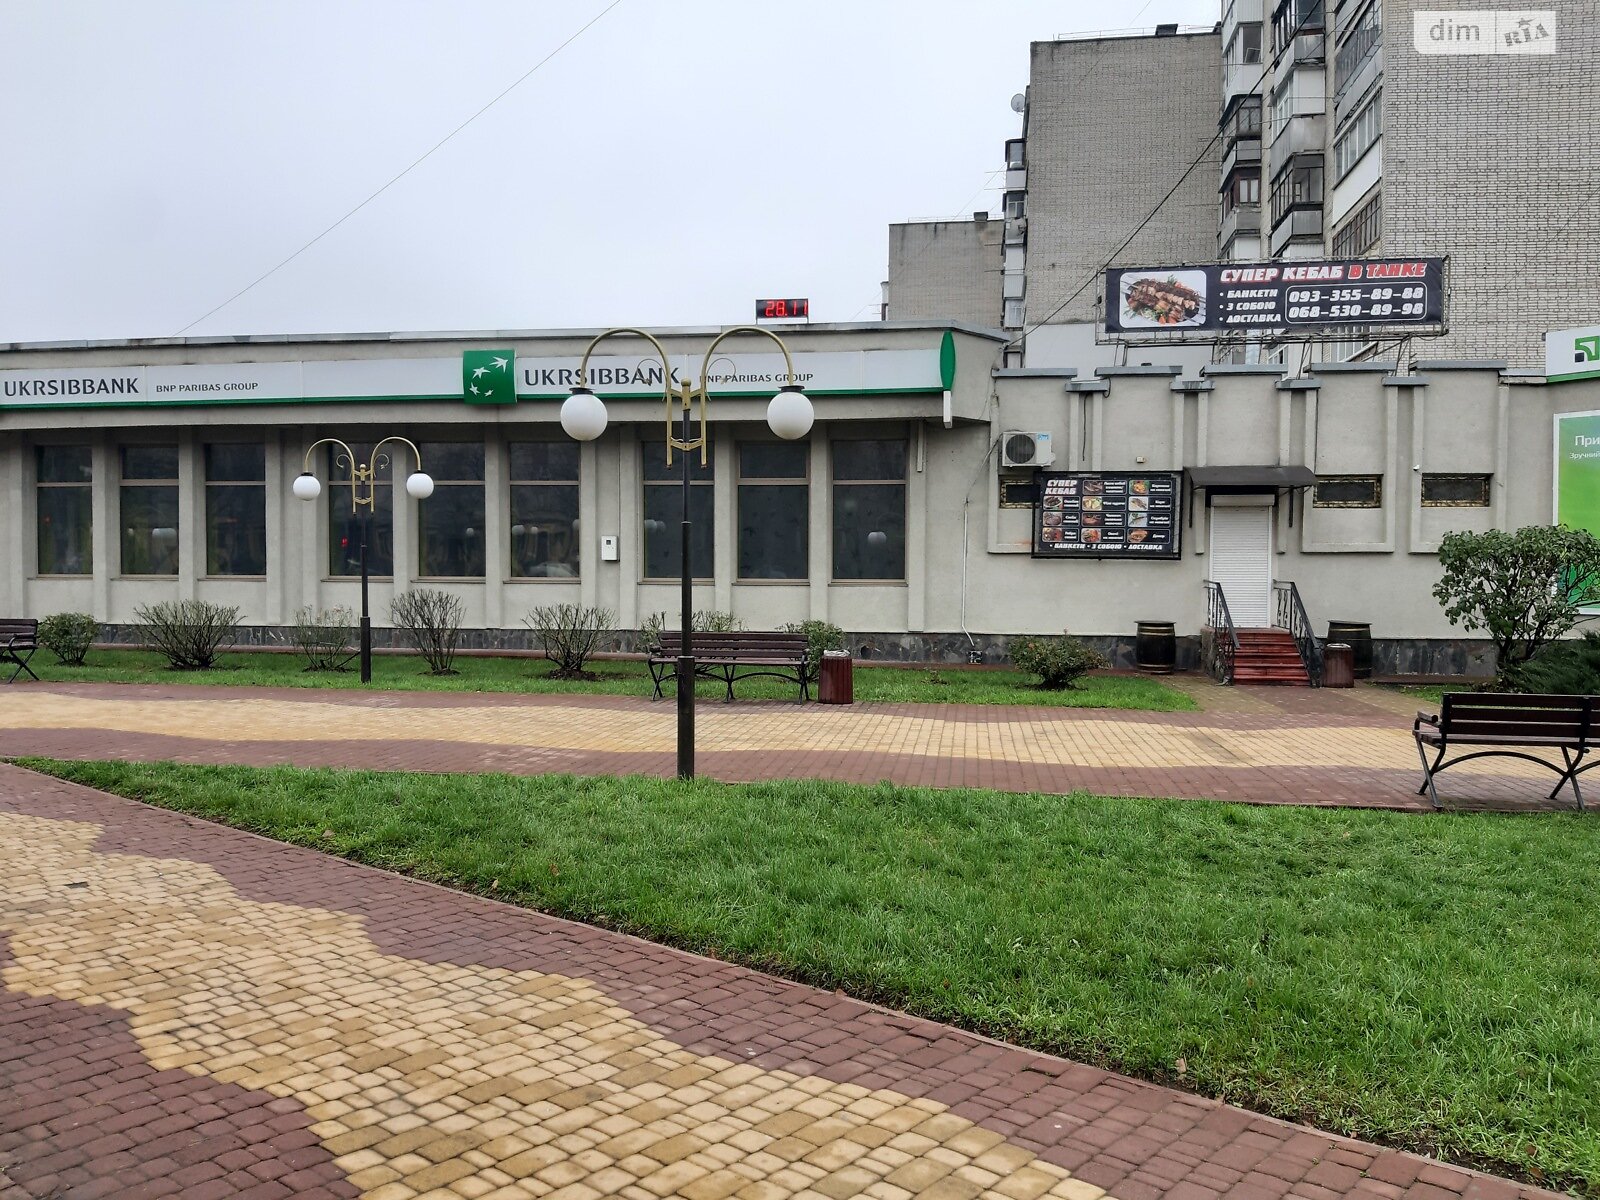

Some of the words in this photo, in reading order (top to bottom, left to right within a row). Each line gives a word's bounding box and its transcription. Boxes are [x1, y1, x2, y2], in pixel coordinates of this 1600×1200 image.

[1219, 267, 1280, 283] СУПЕР
[1281, 265, 1345, 282] КЕБАБ
[1347, 264, 1363, 280] В
[1366, 262, 1428, 278] ТАНКЕ
[1226, 288, 1279, 299] БАНКЕТИ
[1288, 287, 1424, 303] 093-355-89-88
[765, 300, 808, 317] 28.11
[1236, 301, 1276, 310] СОБОЮ
[1288, 303, 1424, 319] 068-530-89-98
[1226, 313, 1282, 323] ДОСТАВКА
[725, 373, 772, 383] PARIBAS
[4, 377, 140, 397] UKRSIBBANK
[156, 384, 176, 393] BNP
[179, 383, 221, 393] PARIBAS
[223, 382, 259, 391] GROUP
[1046, 479, 1078, 487] СУПЕР
[1044, 487, 1077, 495] КЕБАБ
